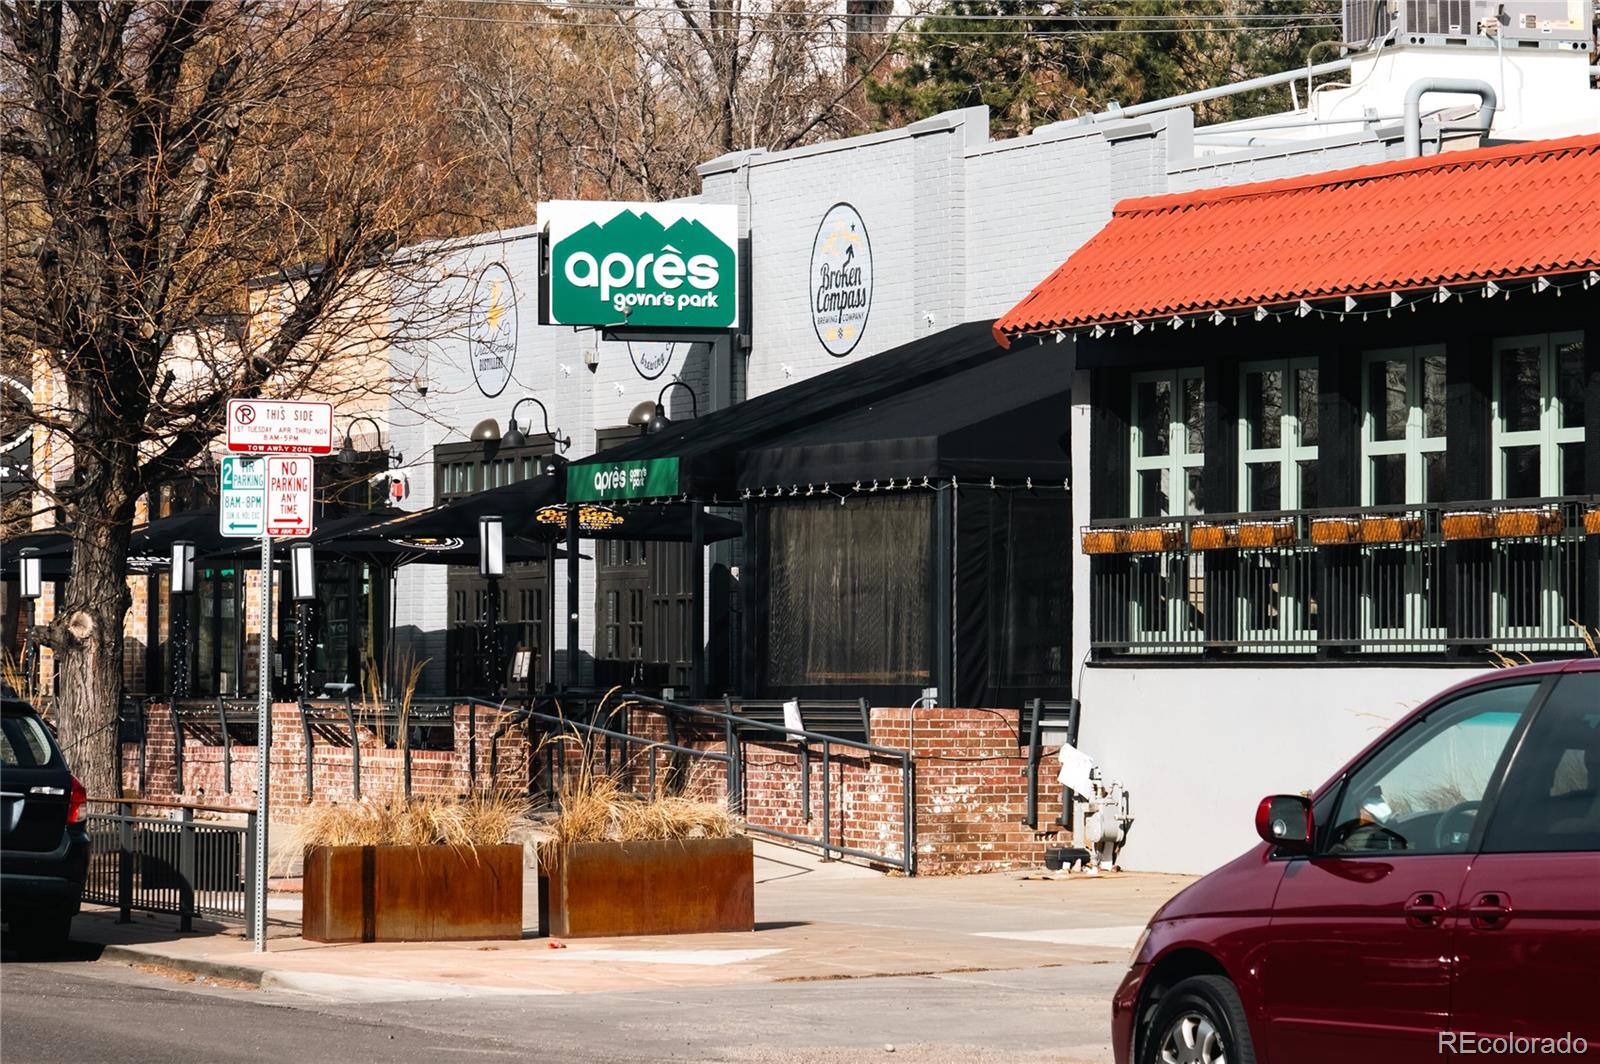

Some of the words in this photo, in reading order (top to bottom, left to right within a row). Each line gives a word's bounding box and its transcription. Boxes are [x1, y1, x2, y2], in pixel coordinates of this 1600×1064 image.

[564, 244, 720, 301] après
[820, 262, 862, 291] Broken
[613, 291, 675, 312] govnr's
[677, 291, 719, 311] park
[816, 285, 866, 323] Compass
[842, 312, 865, 322] COMPANY
[266, 408, 286, 421] THIS
[294, 409, 314, 421] SIDE
[223, 462, 233, 485] 2
[281, 461, 298, 476] NO
[233, 474, 264, 487] PARKING
[271, 477, 308, 492] PARKING
[594, 466, 627, 497] après
[280, 493, 298, 503] ANY
[280, 504, 298, 515] TIME
